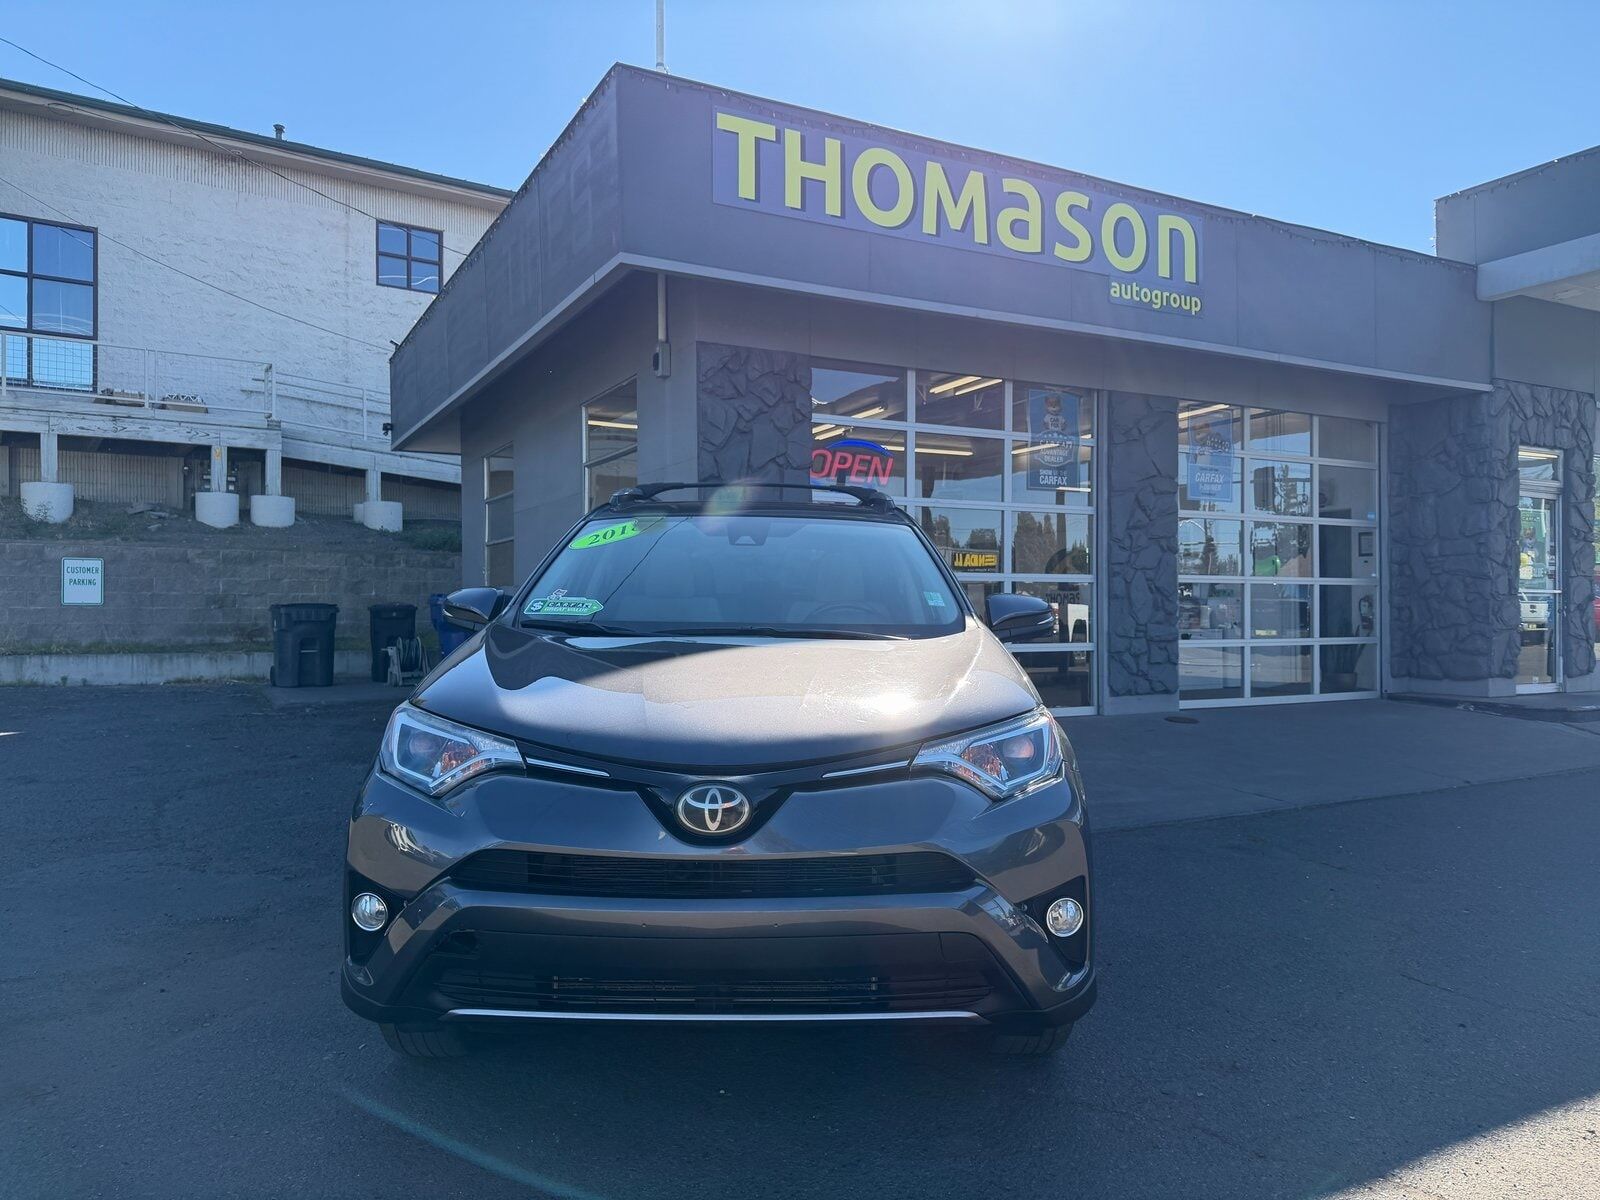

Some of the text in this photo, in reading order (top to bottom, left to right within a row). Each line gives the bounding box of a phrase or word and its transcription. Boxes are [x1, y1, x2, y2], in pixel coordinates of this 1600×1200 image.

[1110, 281, 1202, 315] autogroup
[810, 448, 894, 486] OPEN
[1040, 476, 1067, 486] CARFAX
[1195, 472, 1225, 484] CARFAX
[66, 566, 99, 574] CUSTOMER
